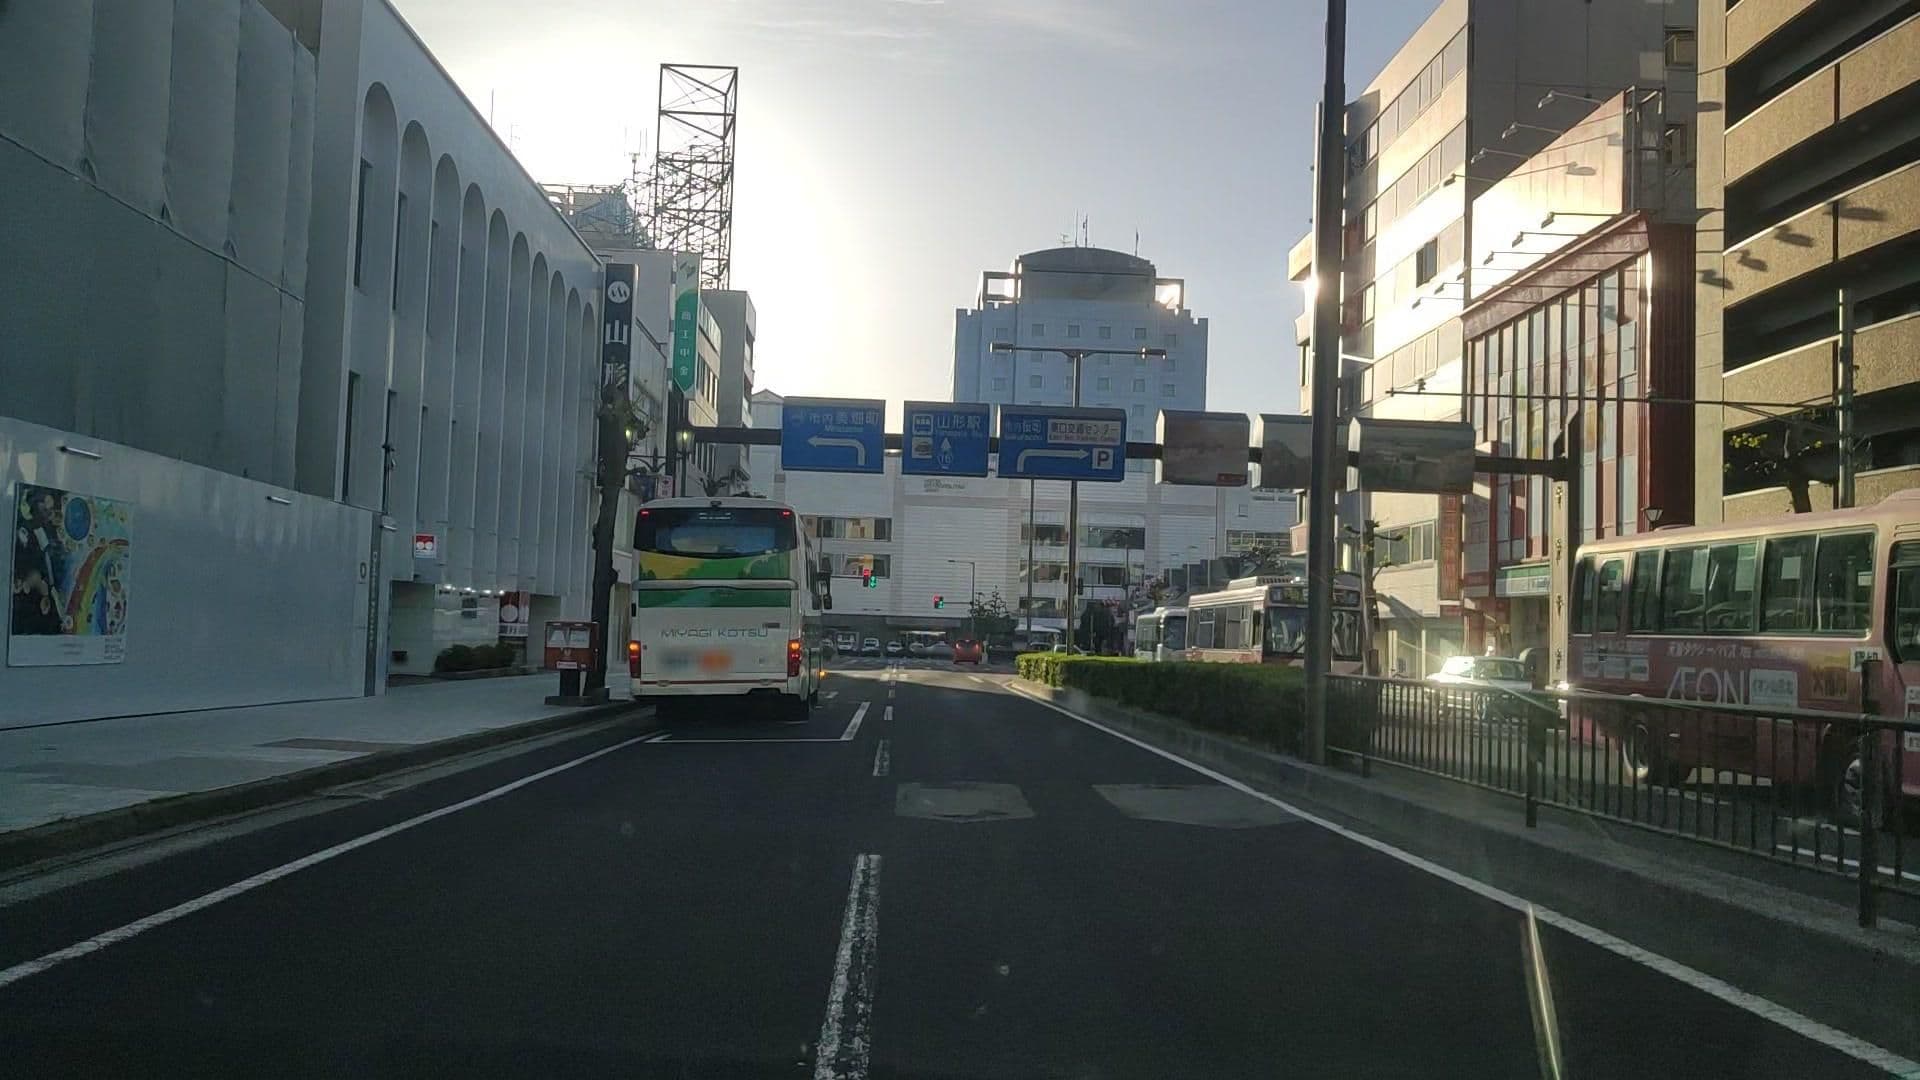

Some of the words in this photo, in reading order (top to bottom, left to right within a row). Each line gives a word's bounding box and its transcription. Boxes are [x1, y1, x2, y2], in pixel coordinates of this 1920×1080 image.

[680, 311, 692, 376] 商工中金
[937, 414, 982, 430] 山形駅
[661, 628, 713, 638] MIYAGI
[718, 628, 768, 638] KOTSU
